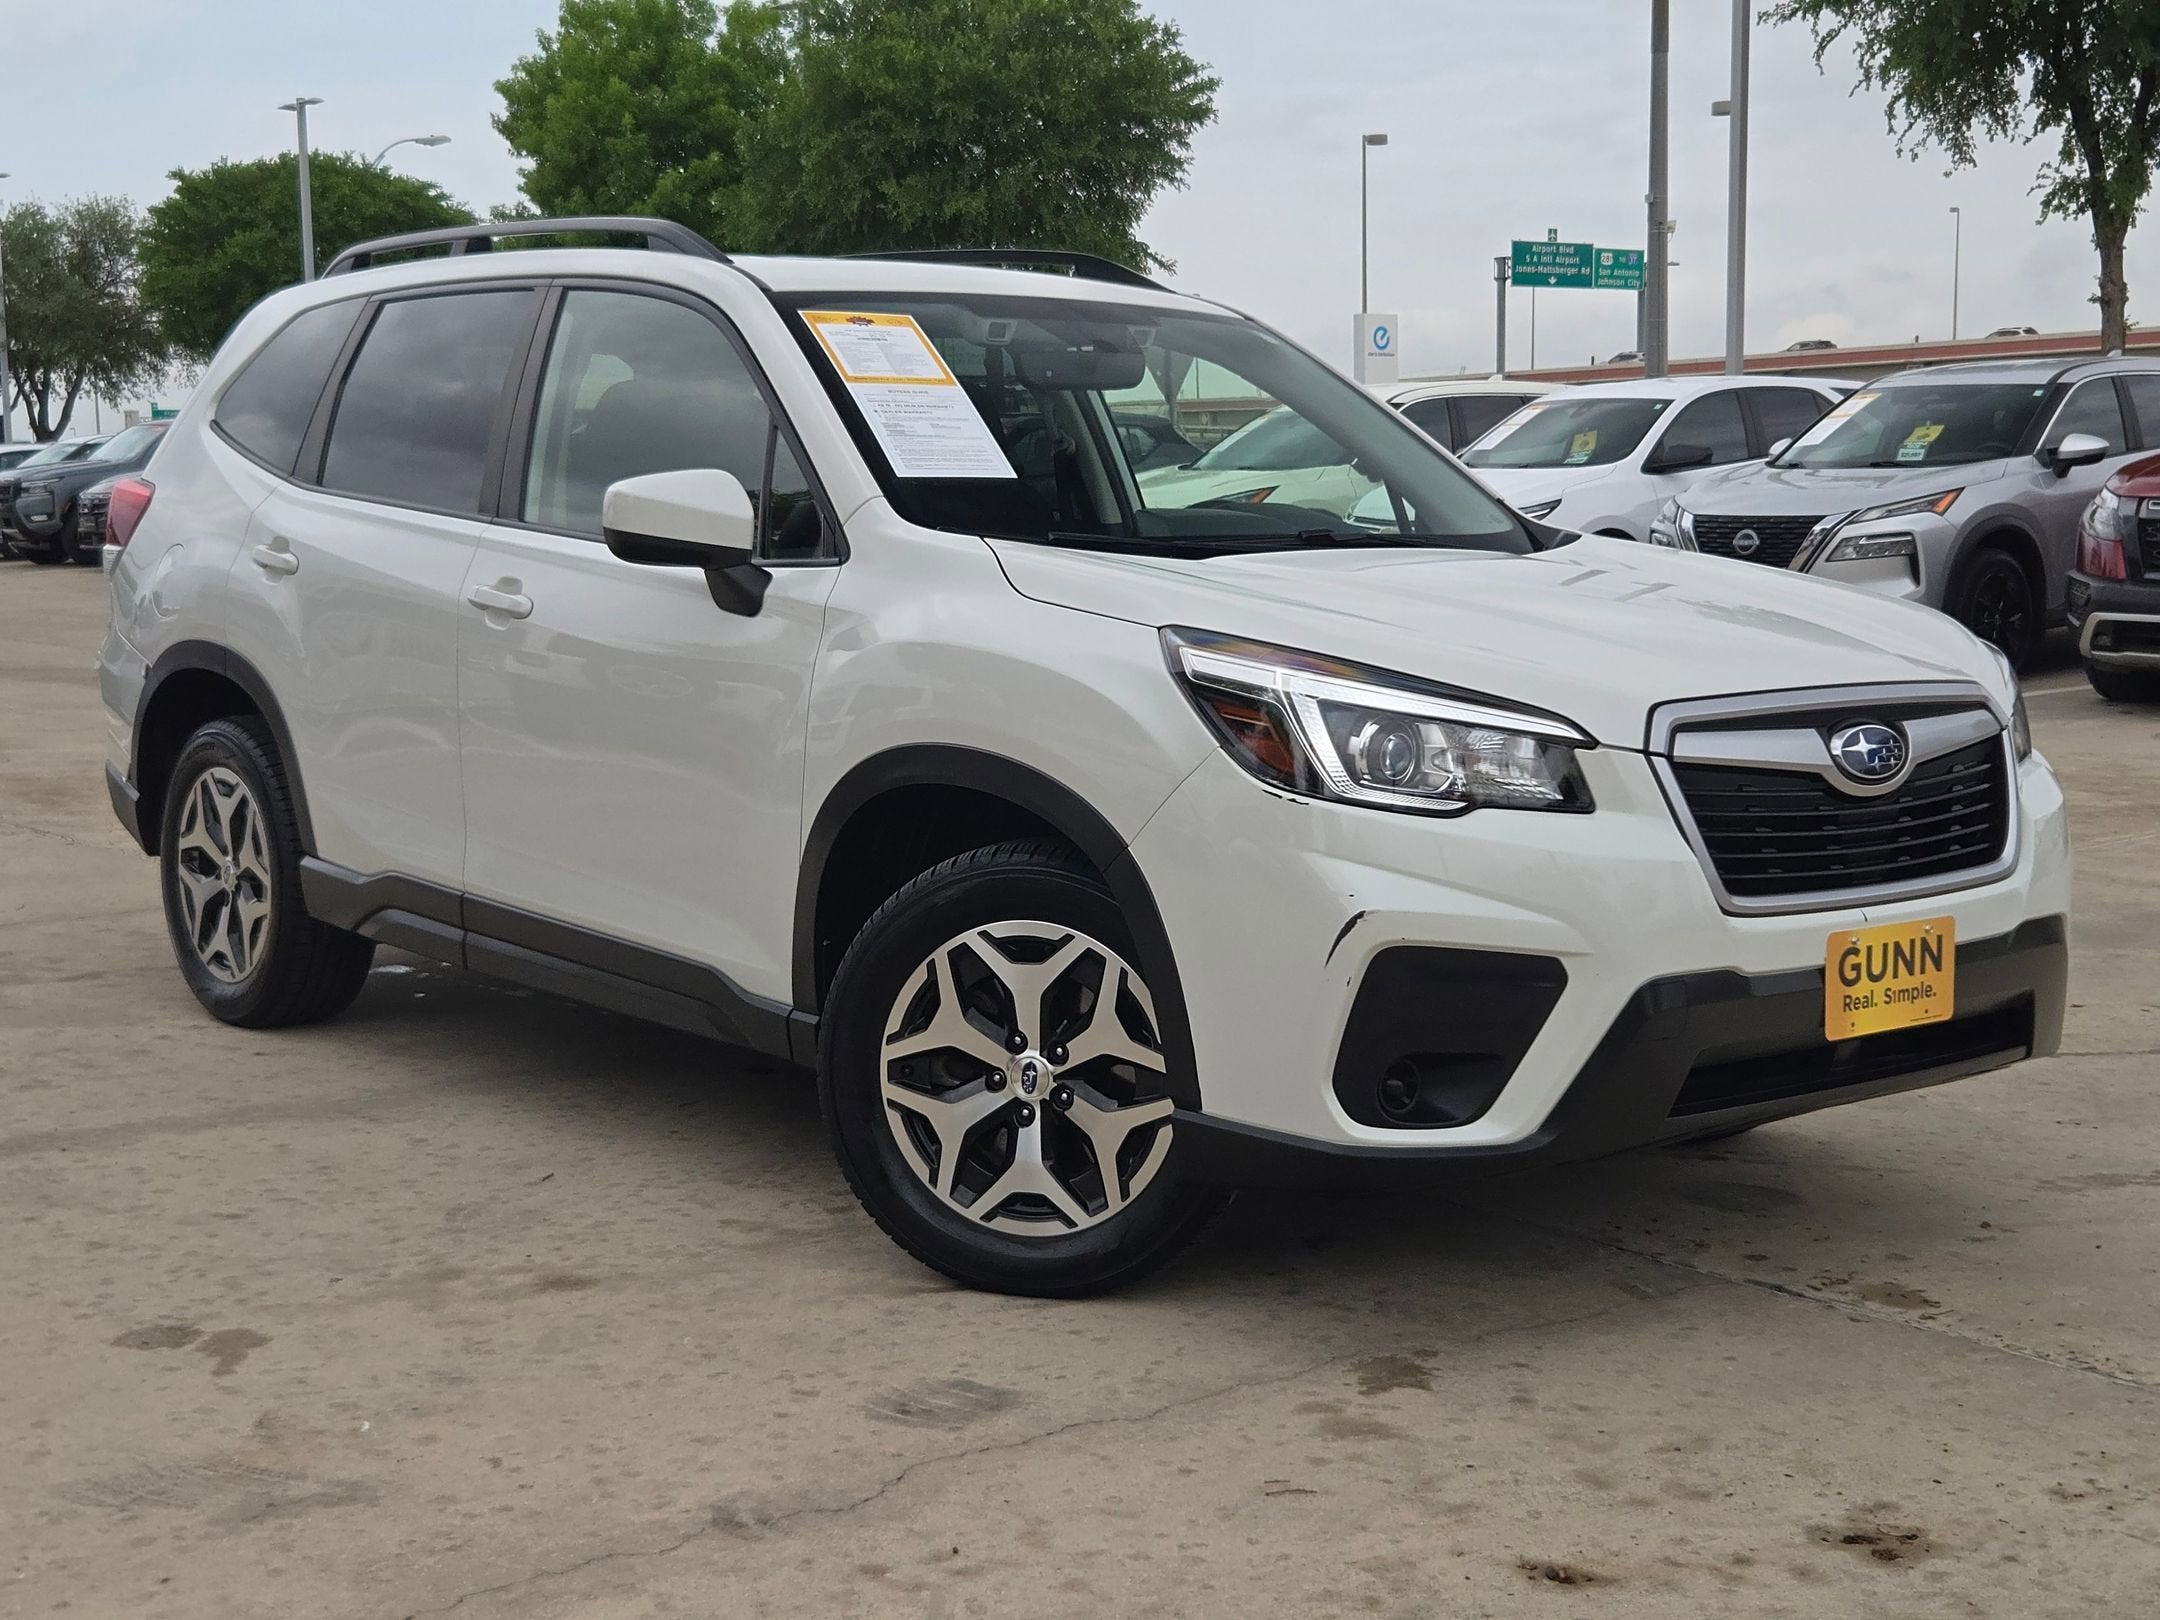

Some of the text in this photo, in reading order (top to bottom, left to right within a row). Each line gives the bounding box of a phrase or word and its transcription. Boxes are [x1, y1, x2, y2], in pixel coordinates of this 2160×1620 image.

[1532, 244, 1574, 254] Airport Blvd
[1555, 256, 1580, 265] Airport
[1581, 267, 1590, 275] Rd
[1613, 268, 1640, 277] Antonio
[1597, 277, 1641, 288] Johnson City
[1838, 934, 1943, 987] GUNN
[1843, 990, 1878, 1012] Real.
